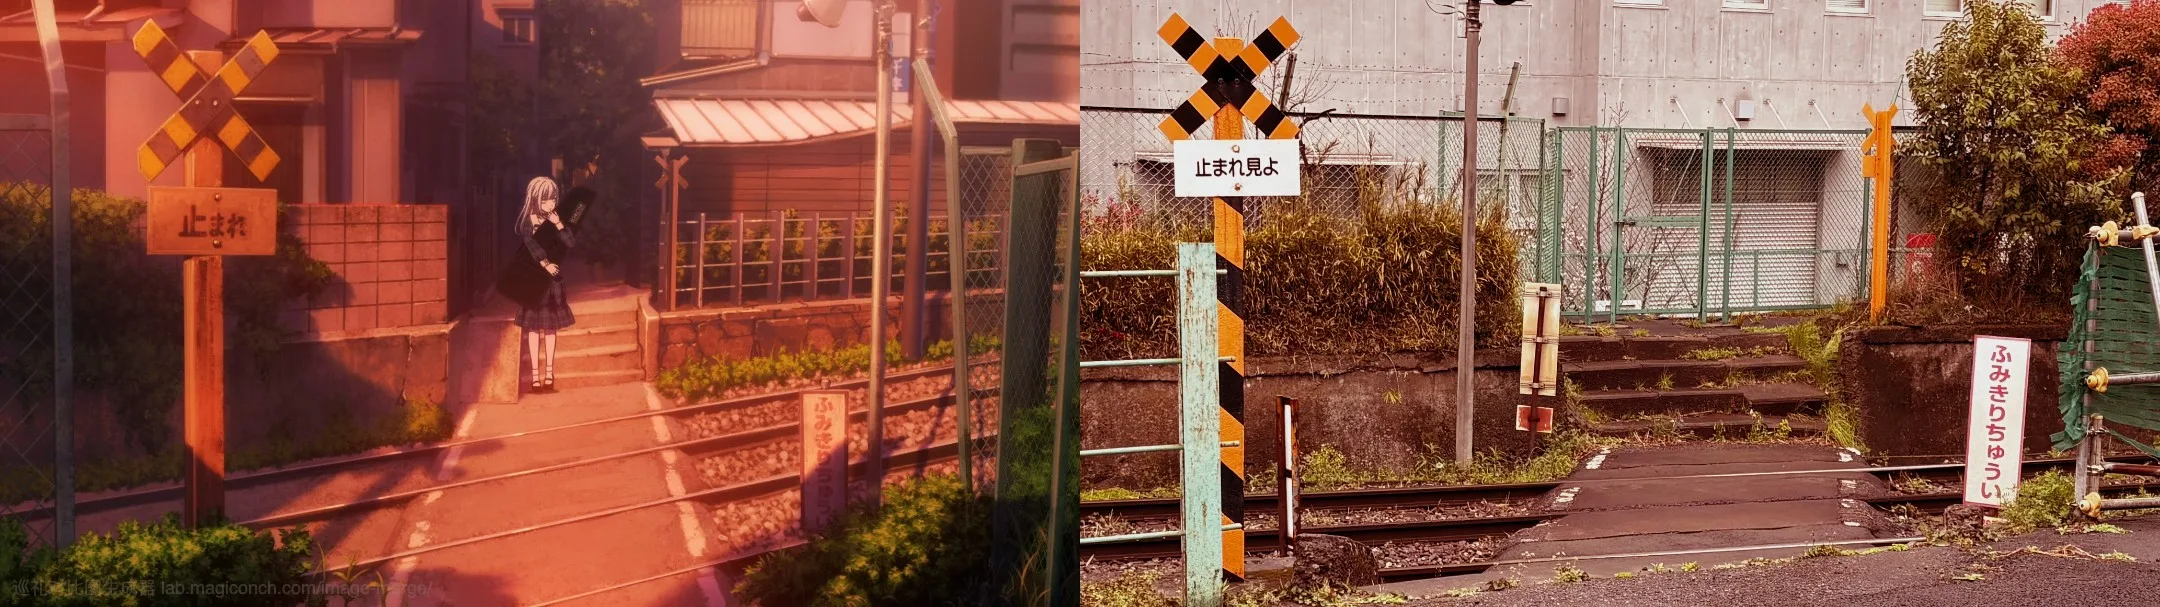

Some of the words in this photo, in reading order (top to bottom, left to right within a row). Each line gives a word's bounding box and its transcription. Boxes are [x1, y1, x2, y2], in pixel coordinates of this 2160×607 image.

[1195, 157, 1279, 177] 止まれ見よ
[178, 205, 247, 238] 止まれ
[1981, 345, 2012, 499] ふみきりちゅうい
